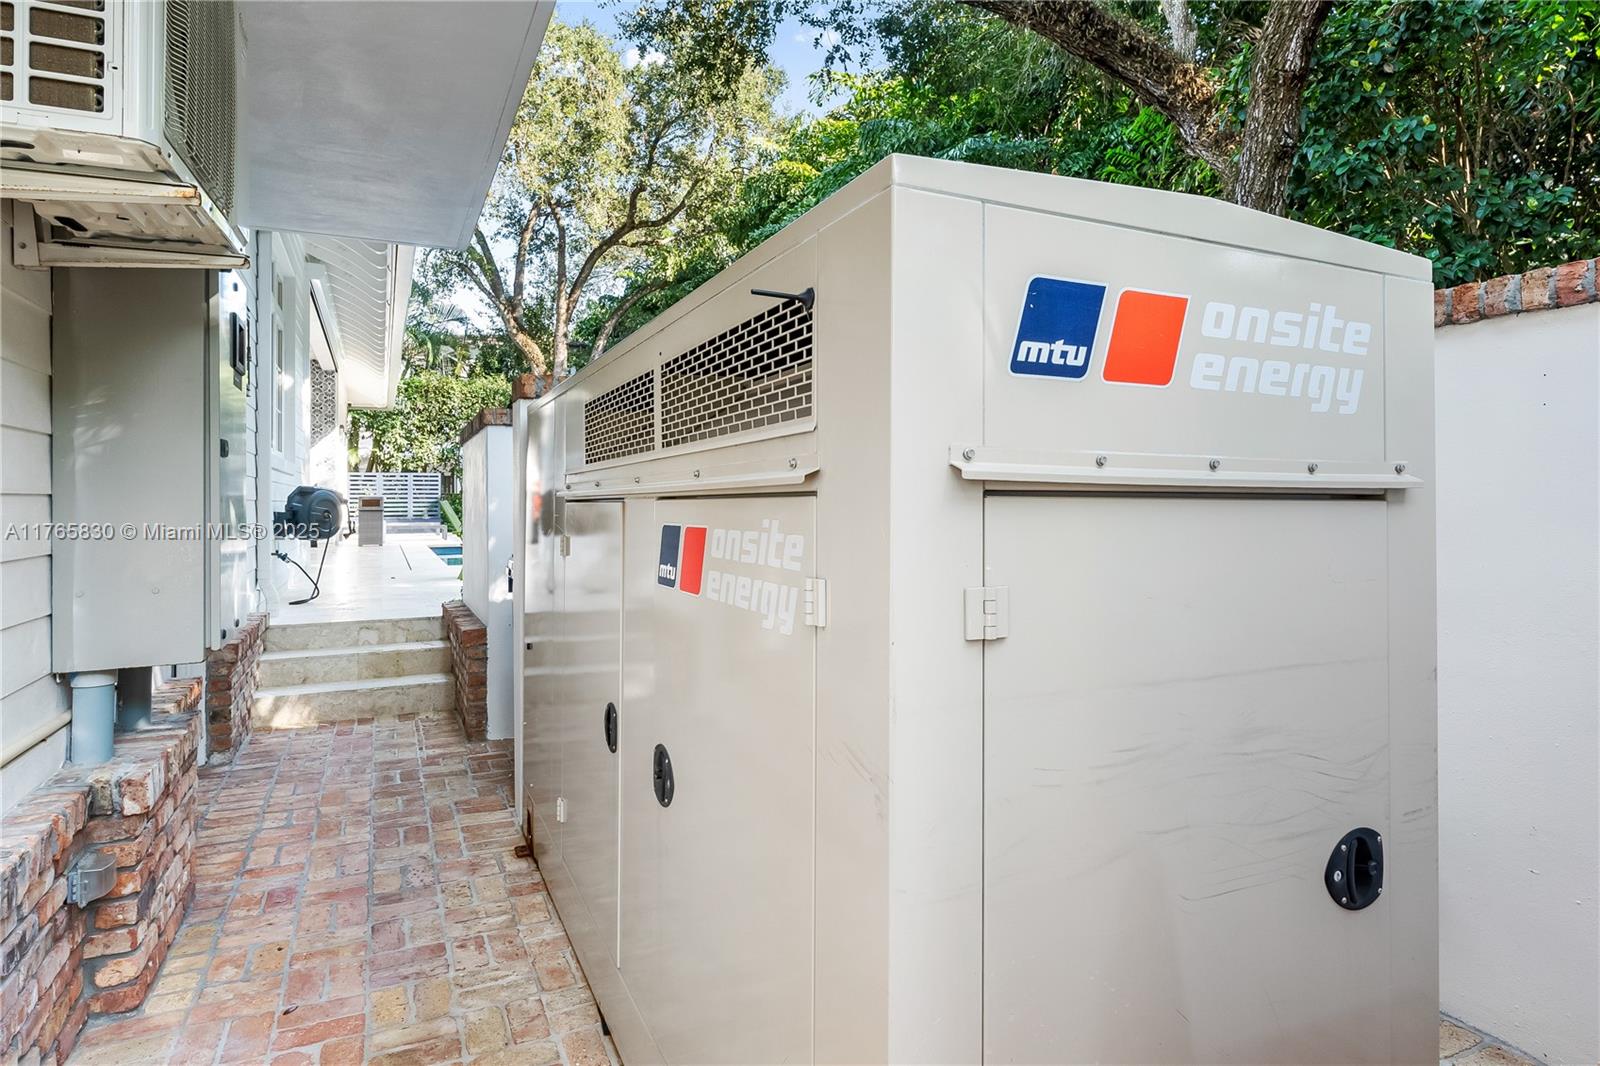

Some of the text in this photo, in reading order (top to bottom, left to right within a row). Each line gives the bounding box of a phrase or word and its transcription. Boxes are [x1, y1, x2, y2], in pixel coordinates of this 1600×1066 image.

[1016, 338, 1088, 367] mtu
[1201, 301, 1372, 356] onsite
[1190, 352, 1364, 415] energy
[659, 563, 676, 580] mtu
[710, 519, 804, 572] onsite
[706, 570, 799, 636] energy
